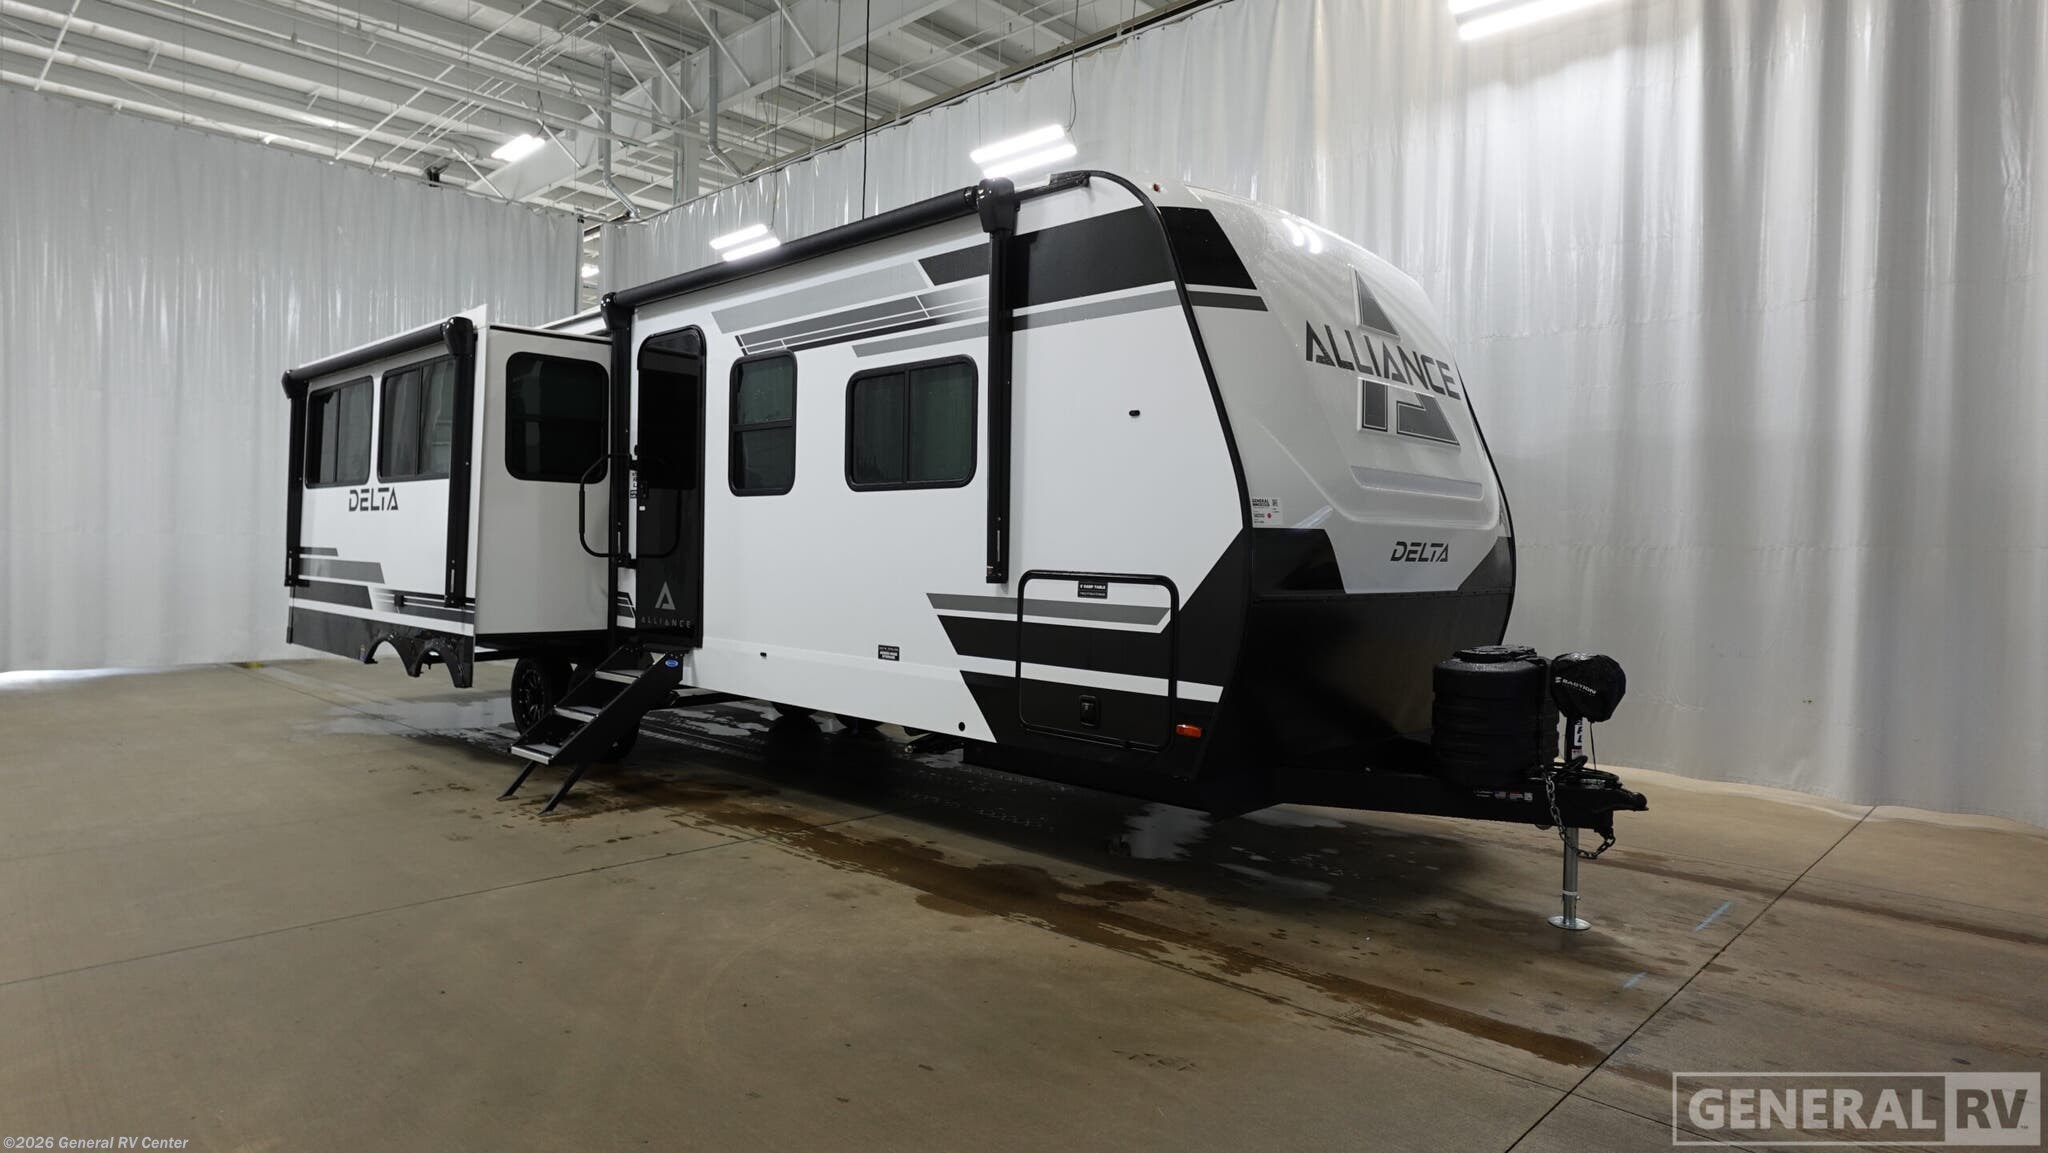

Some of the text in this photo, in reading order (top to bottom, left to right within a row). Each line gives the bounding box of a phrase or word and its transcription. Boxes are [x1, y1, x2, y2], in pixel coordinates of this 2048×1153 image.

[1305, 319, 1461, 401] ALLIANCE
[349, 487, 399, 512] DELTA
[1390, 541, 1449, 563] DELTA
[641, 616, 691, 628] ALLIANCE
